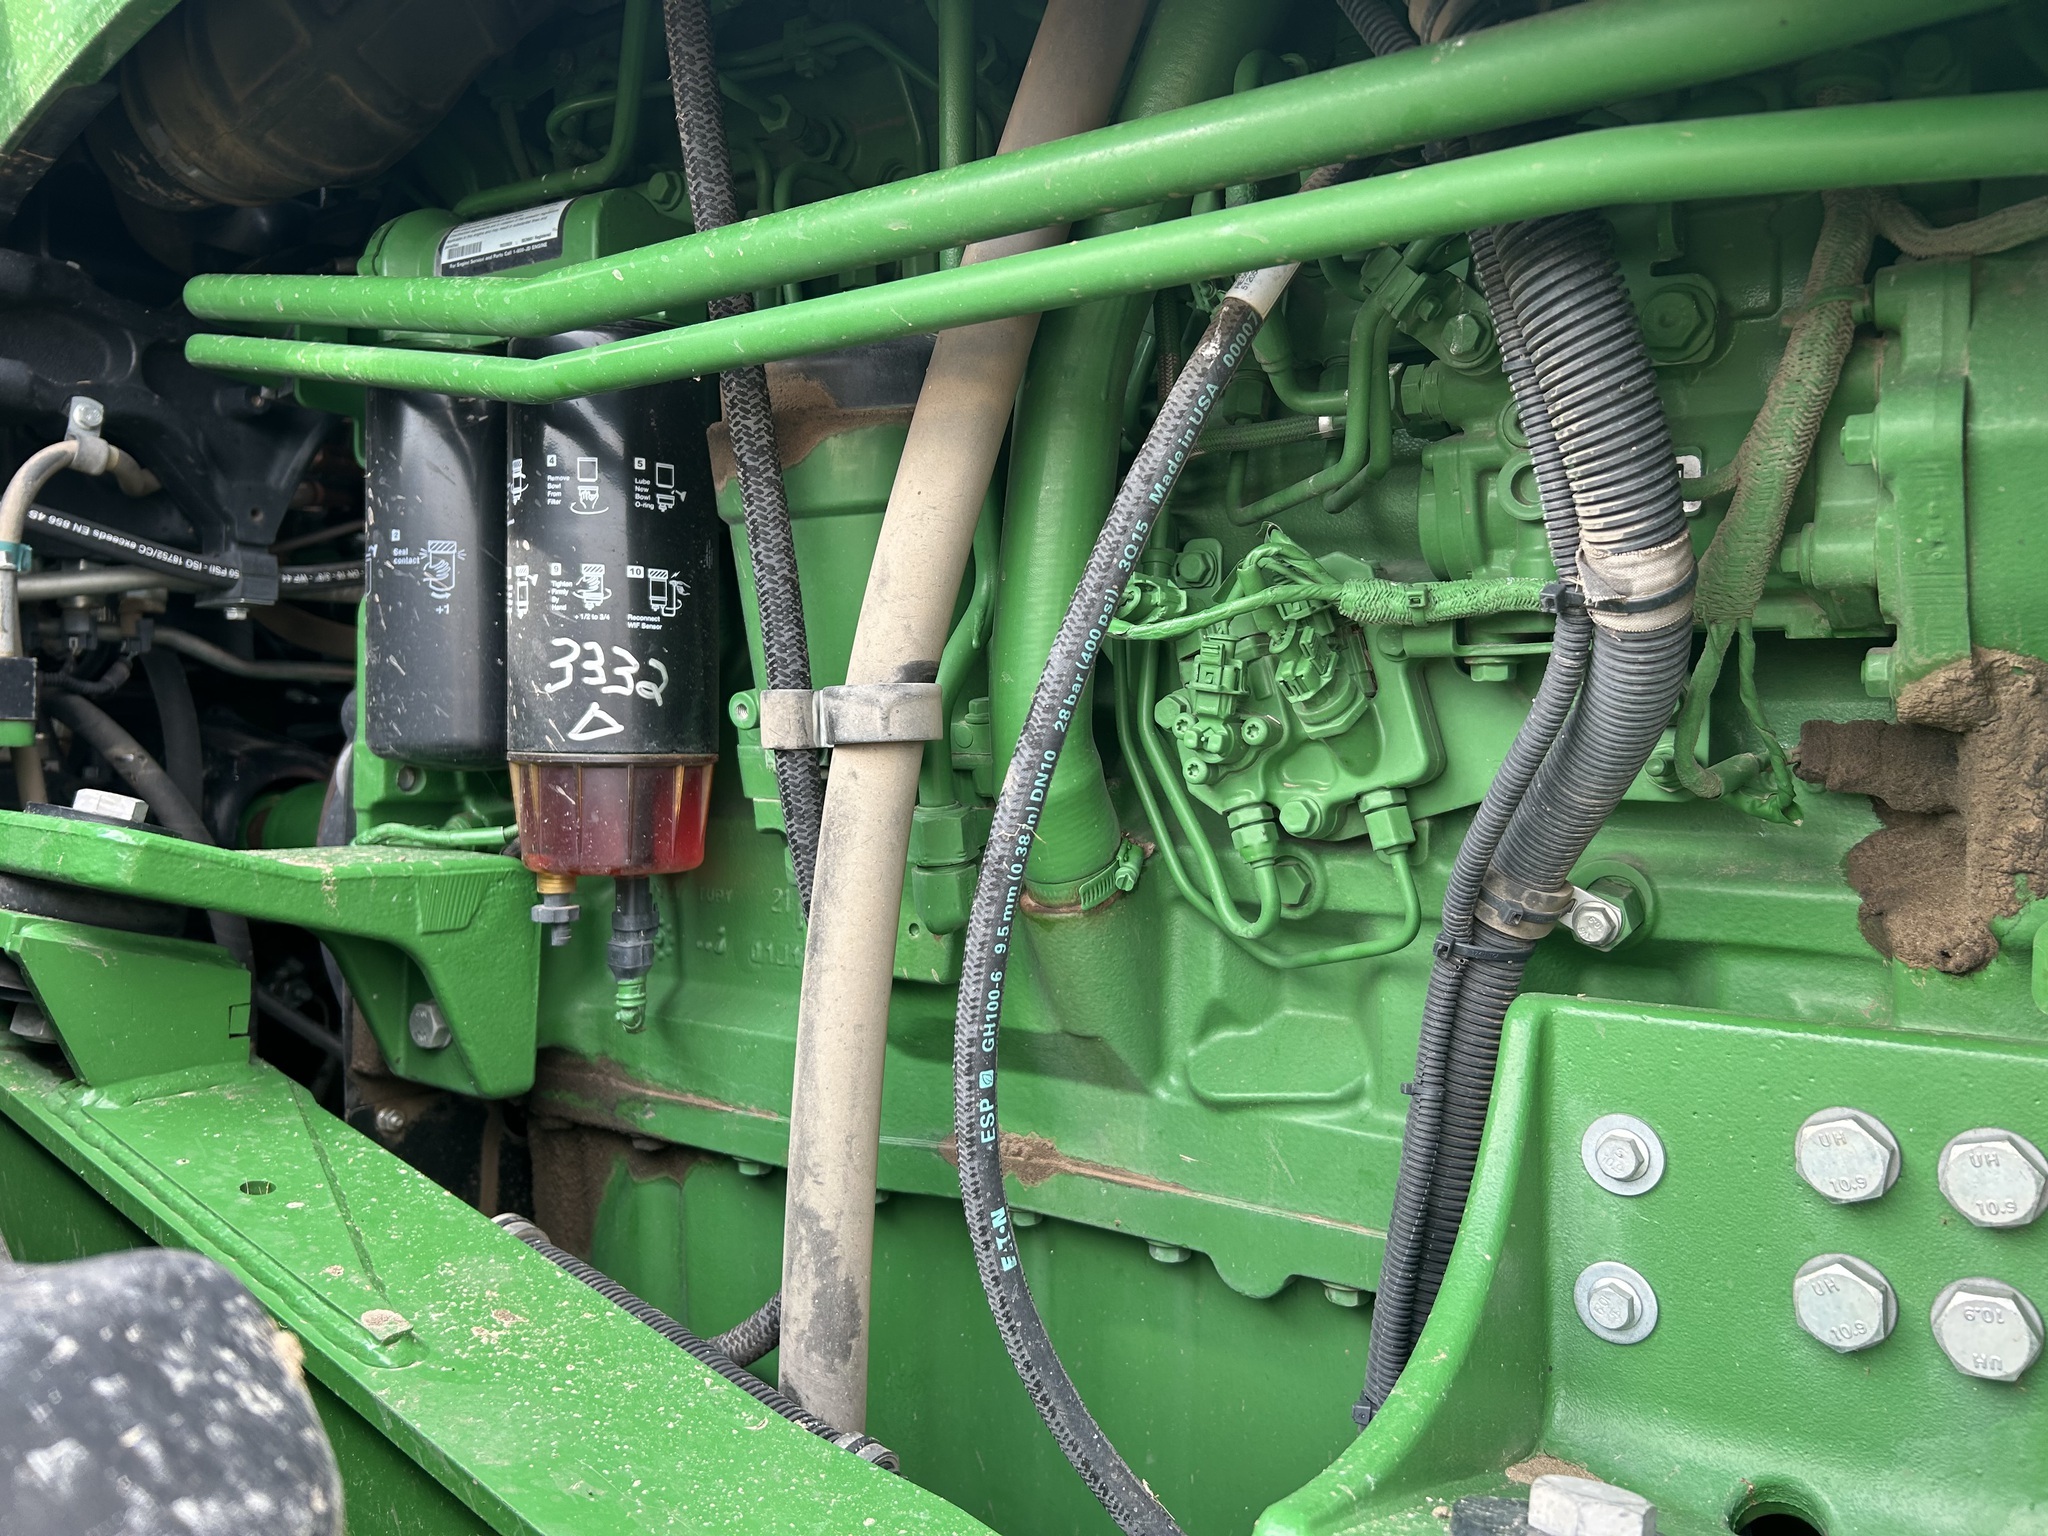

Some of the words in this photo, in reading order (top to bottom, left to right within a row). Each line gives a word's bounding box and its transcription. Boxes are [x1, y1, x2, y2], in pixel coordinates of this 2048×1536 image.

[1223, 314, 1261, 368] 00007
[1189, 383, 1220, 426] USA
[1178, 429, 1196, 448] in
[1149, 451, 1184, 505] Made
[635, 501, 654, 510] O-ring
[72, 522, 90, 536] EN
[92, 529, 136, 550] exceeds
[393, 547, 408, 556] Seal
[1119, 519, 1148, 572] 3Q15
[185, 559, 202, 571] ISO
[393, 556, 420, 565] contact
[436, 604, 450, 614] +1
[1098, 588, 1119, 627] psi)
[642, 622, 662, 630] Sensor
[1076, 628, 1101, 670] (400
[1064, 674, 1084, 706] bar
[1054, 708, 1072, 733] 28
[1030, 750, 1057, 802] DN10
[1007, 835, 1031, 881] (0.38
[1002, 885, 1018, 922] mm
[994, 925, 1009, 954] 9.5
[981, 970, 1003, 1052] GH100-6
[979, 1098, 996, 1143] ESP
[1818, 1131, 1848, 1148] UH
[1970, 1152, 2000, 1168] UH
